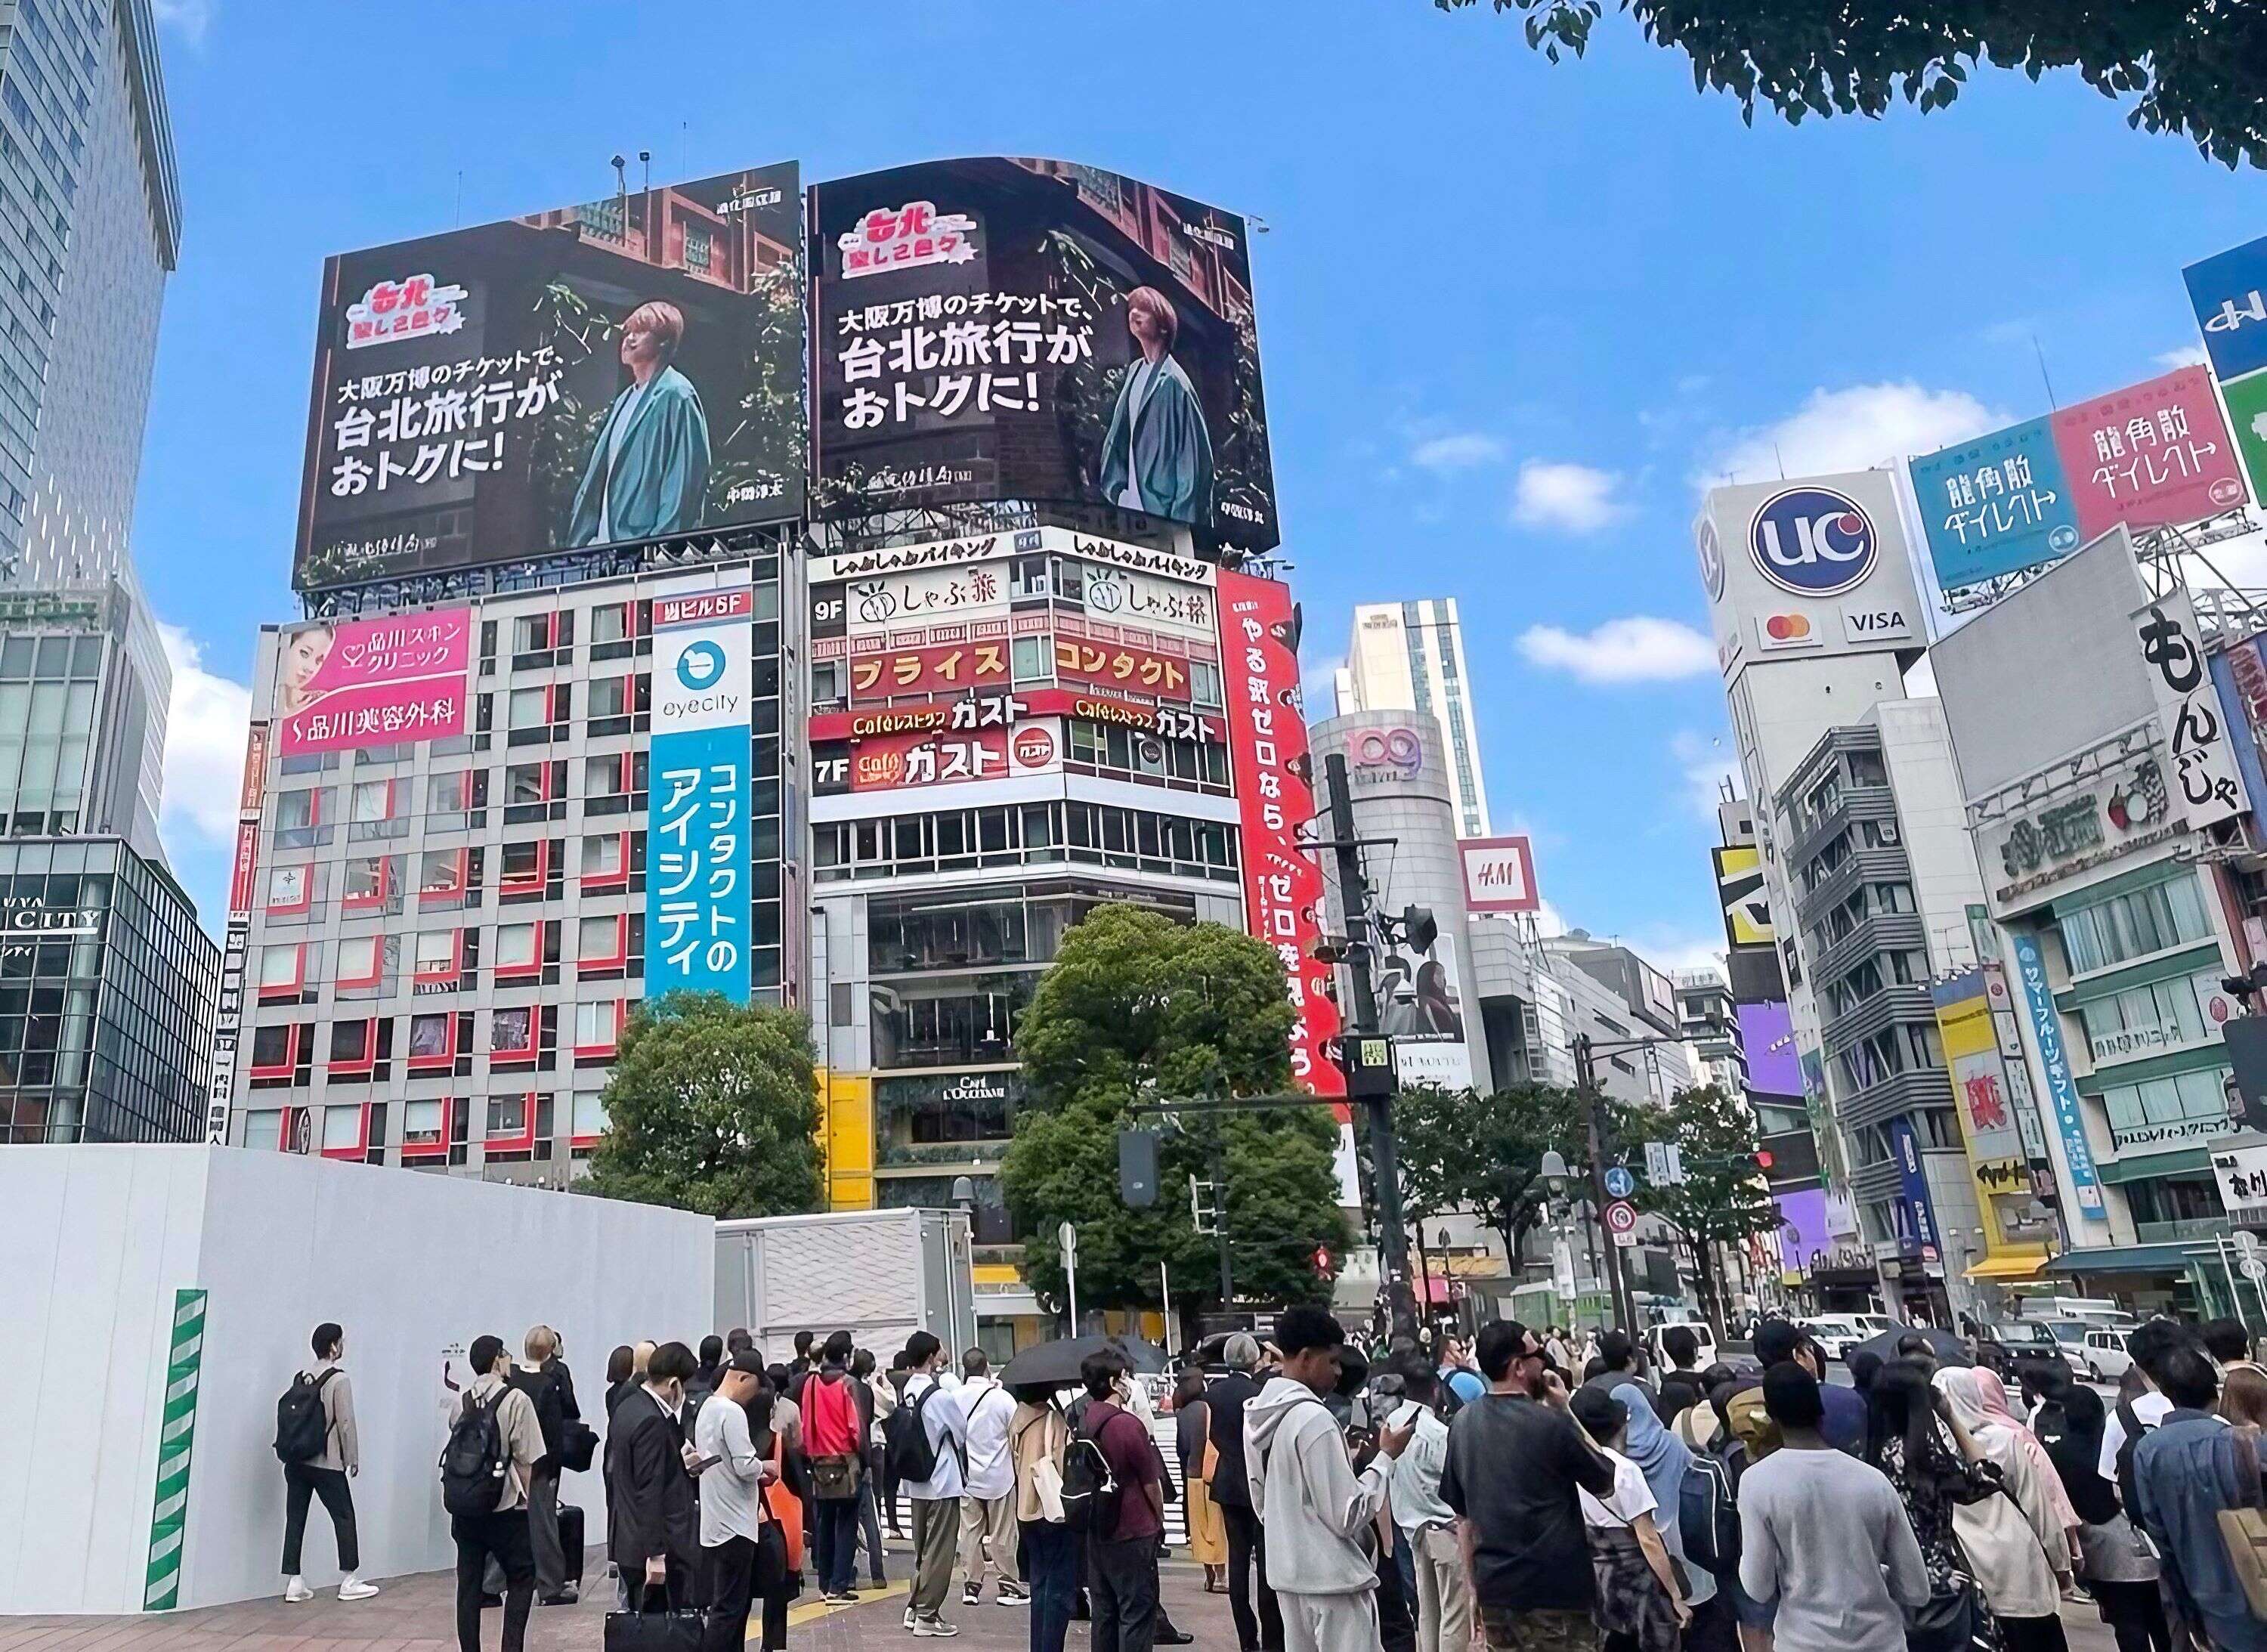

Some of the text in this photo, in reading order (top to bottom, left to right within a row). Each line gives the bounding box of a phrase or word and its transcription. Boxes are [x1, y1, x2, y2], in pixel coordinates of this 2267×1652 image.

[837, 292, 1093, 335] 大阪万博のチケットで、
[837, 320, 1093, 382] 台北旅行が
[337, 345, 564, 404] 大阪万博のチケットで、
[333, 370, 564, 452] 台北旅行が
[841, 372, 1040, 430] おトクに!
[329, 432, 505, 497] おトクに!
[1761, 511, 1864, 566] UC
[814, 600, 844, 622] 9F
[1848, 611, 1906, 631] VISA
[367, 623, 461, 653] 品川スキン
[367, 646, 450, 675] クリニック
[852, 645, 1007, 691] プライス
[1056, 641, 1185, 690] コンタクト
[307, 697, 456, 742] 品川美容外科
[663, 694, 738, 718] eyecity
[951, 695, 1028, 729] ガスト
[1155, 708, 1216, 744] ガスト
[2139, 607, 2238, 811] もんじゃ
[814, 758, 851, 784] 7F
[905, 741, 1001, 784] ガスト
[1346, 729, 1423, 782] 109
[658, 768, 701, 975] アイシティ
[707, 764, 738, 973] コンタクトの
[14, 910, 102, 929] CITY
